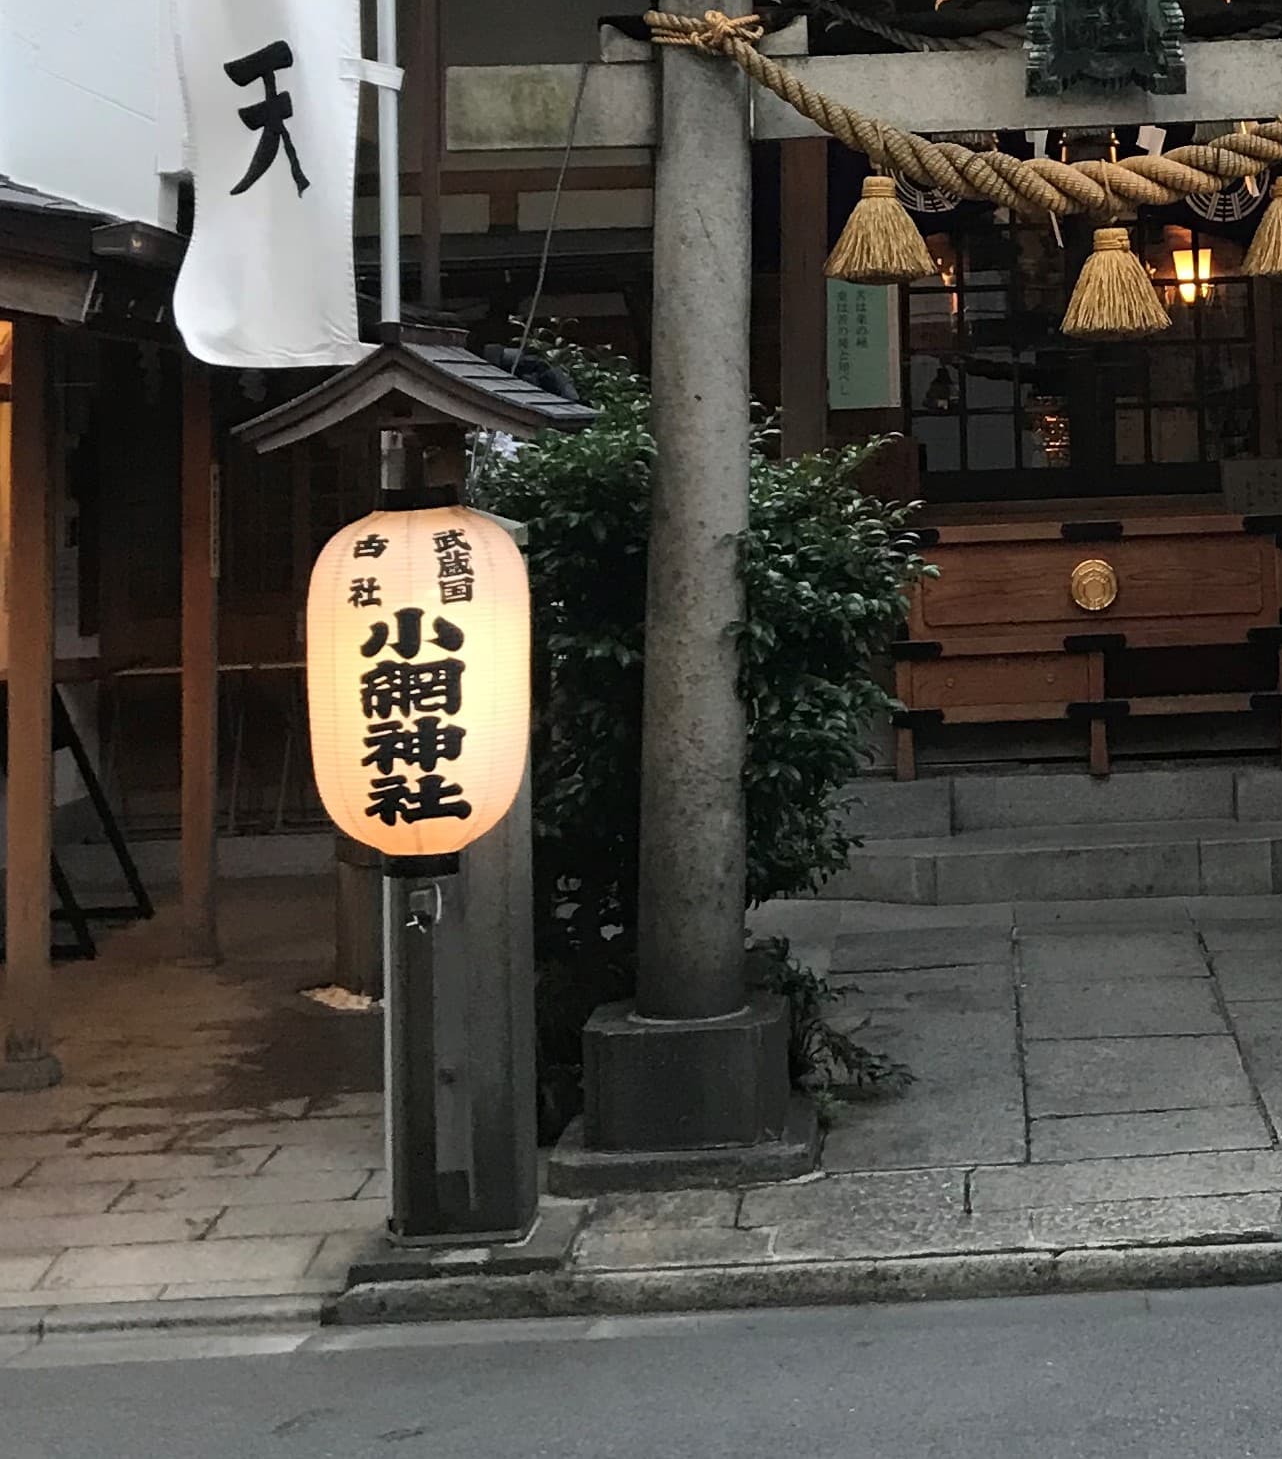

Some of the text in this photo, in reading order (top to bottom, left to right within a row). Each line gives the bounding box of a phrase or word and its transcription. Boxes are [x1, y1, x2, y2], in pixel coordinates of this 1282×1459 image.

[348, 534, 389, 607] 古社
[433, 529, 474, 604] 武蔵国
[361, 607, 472, 826] 小網神社
